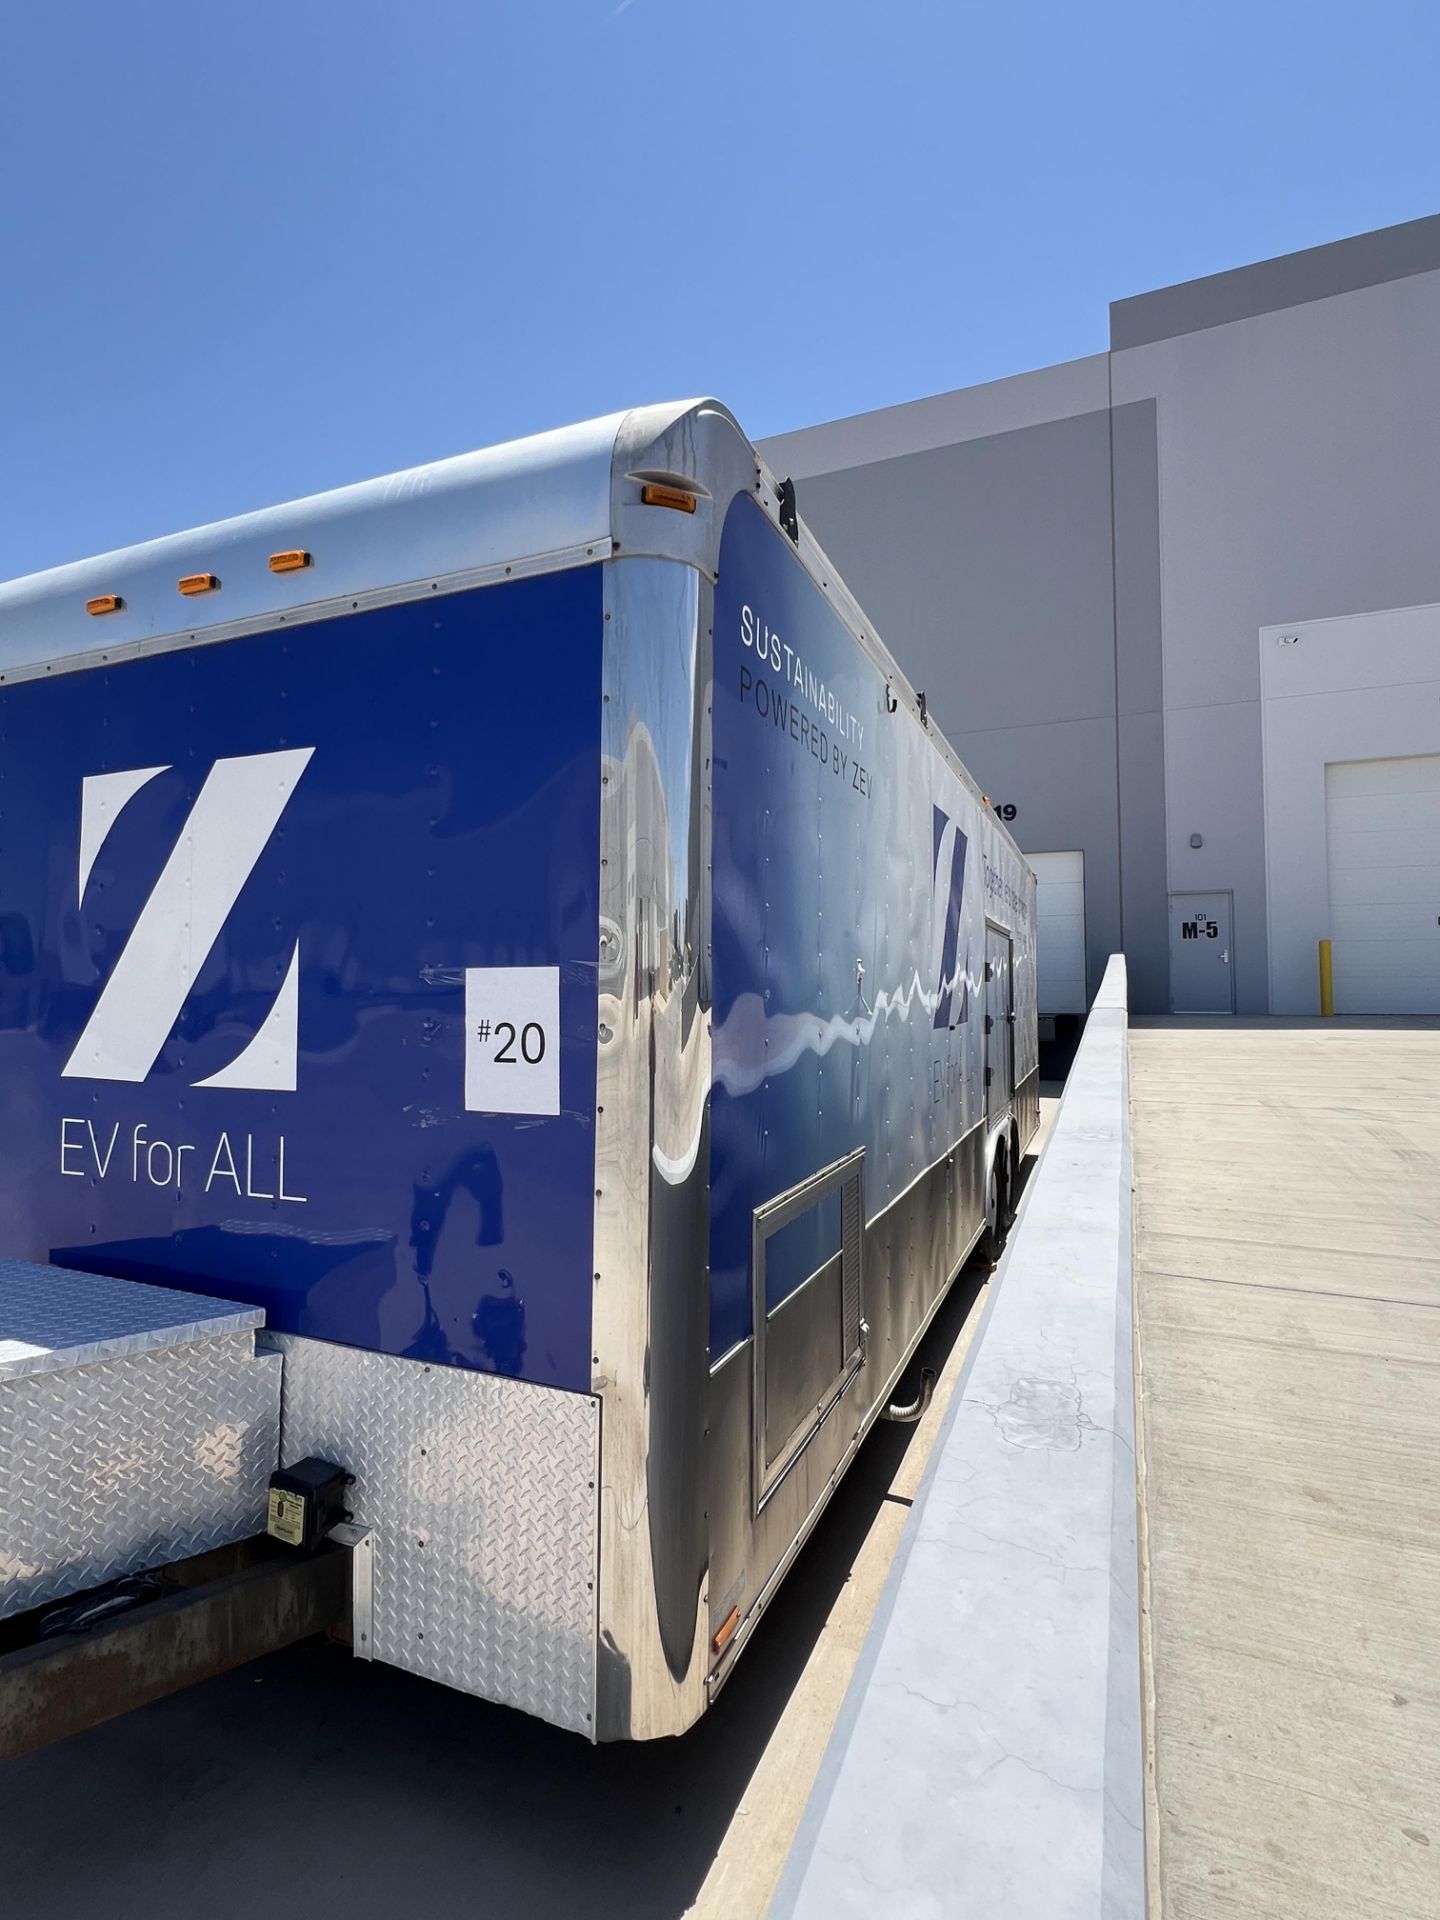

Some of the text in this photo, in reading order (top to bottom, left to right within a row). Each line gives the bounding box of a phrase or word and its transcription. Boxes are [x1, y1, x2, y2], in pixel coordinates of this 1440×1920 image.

[740, 605, 864, 751] SUSTAINABILITY
[740, 664, 873, 800] POWERED BY ZEV
[1182, 921, 1218, 939] M-5
[1194, 913, 1207, 921] 101
[477, 1019, 546, 1065] #20
[61, 1118, 307, 1202] EV for ALL
